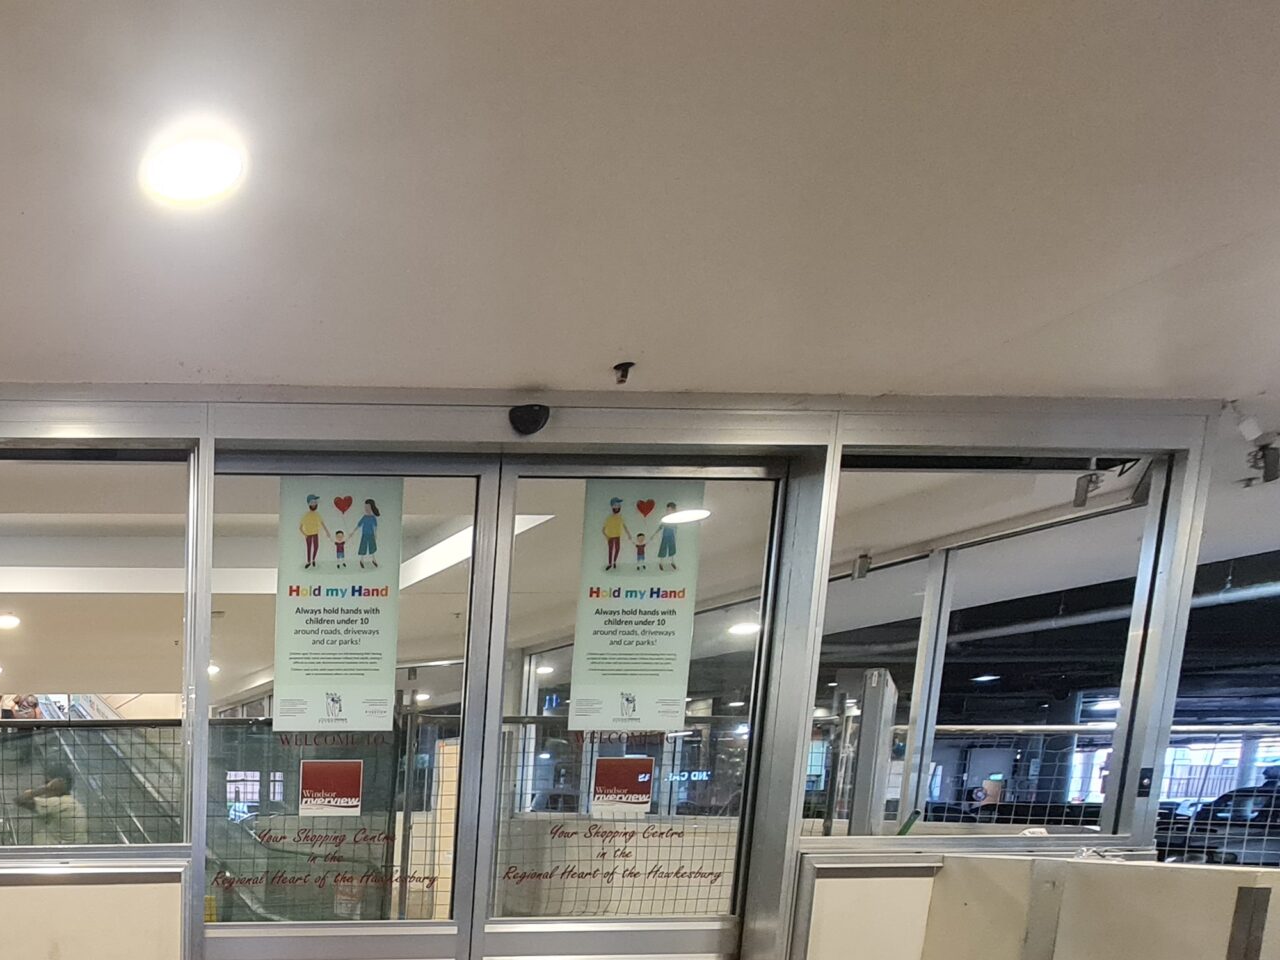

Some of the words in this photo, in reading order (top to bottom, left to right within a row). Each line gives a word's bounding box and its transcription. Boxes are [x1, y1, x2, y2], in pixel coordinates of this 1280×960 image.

[288, 585, 321, 597] Hold
[325, 588, 348, 598] my
[351, 585, 389, 597] Hand
[588, 587, 621, 599] Hold
[624, 590, 647, 600] my
[649, 587, 686, 599] Hand
[295, 607, 322, 616] Always
[323, 607, 339, 615] hold
[340, 607, 362, 615] hands
[363, 607, 380, 615] with
[594, 608, 620, 617] Always
[621, 608, 637, 616] hold
[638, 608, 659, 616] hands
[660, 608, 677, 616] with
[604, 618, 633, 626] children
[320, 628, 342, 636] roads,
[343, 628, 380, 637] driveways
[640, 629, 676, 637] driveways
[338, 638, 361, 647] parks!
[279, 734, 358, 746] WELCOME
[302, 789, 337, 798] Windsor
[595, 786, 629, 794] Windsor
[301, 797, 360, 805] riverview
[594, 793, 651, 802] riverview
[258, 829, 287, 844] Your
[292, 828, 347, 848] Shopping
[353, 828, 396, 843] Centre
[550, 825, 578, 840] Your
[583, 824, 636, 844] Shopping
[642, 824, 685, 839] Centre
[307, 851, 319, 863] in
[324, 850, 344, 863] the
[596, 847, 607, 859] in
[613, 846, 632, 859] the
[502, 865, 559, 884] Regional
[559, 864, 599, 880] Heart
[603, 865, 620, 884] of
[621, 865, 641, 879] the
[647, 865, 722, 885] Hawkesbury
[211, 870, 266, 890] Regional
[271, 870, 310, 886] Heart
[314, 870, 330, 889] of
[333, 871, 353, 884] the
[360, 869, 439, 888] Hawkesbury
